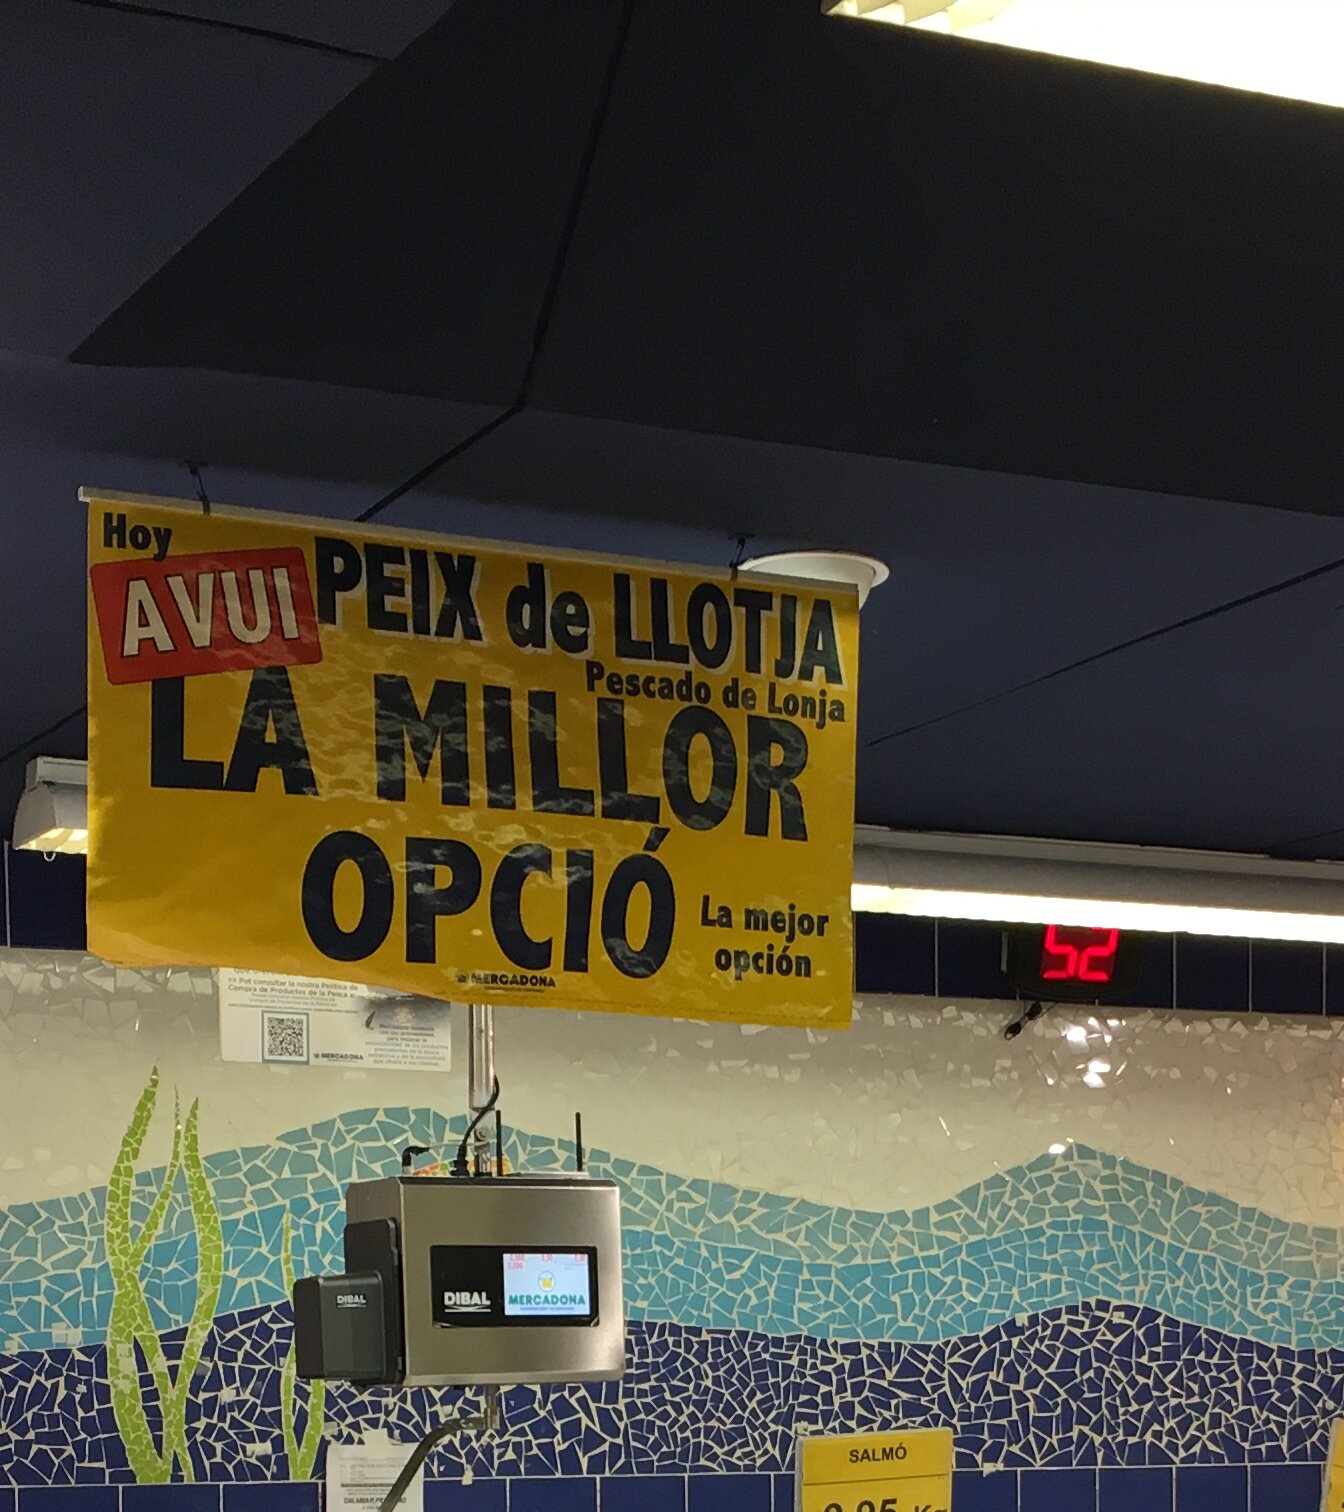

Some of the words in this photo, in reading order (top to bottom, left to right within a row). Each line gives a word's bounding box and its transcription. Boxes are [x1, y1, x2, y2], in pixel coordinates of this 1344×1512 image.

[103, 512, 172, 561] Hoy
[121, 566, 301, 658] AVUI
[315, 536, 483, 641] PEIX
[506, 563, 588, 654] de
[615, 572, 843, 685] LLOTJA
[585, 660, 711, 704] Pescado
[722, 678, 756, 710] de
[768, 682, 845, 729] Lonja
[150, 666, 319, 796] LA
[373, 674, 809, 842] MILLOR
[301, 826, 675, 979] OPCIÓ
[701, 895, 733, 928] La
[744, 903, 829, 943] mejor
[715, 943, 811, 981] opción
[1043, 924, 1120, 981] 52
[471, 972, 556, 988] MERCADONA
[337, 1294, 366, 1304] DIBAL
[444, 1291, 491, 1306] DIBAL
[508, 1294, 586, 1306] MERCADONA
[849, 1443, 907, 1463] SALMÓ
